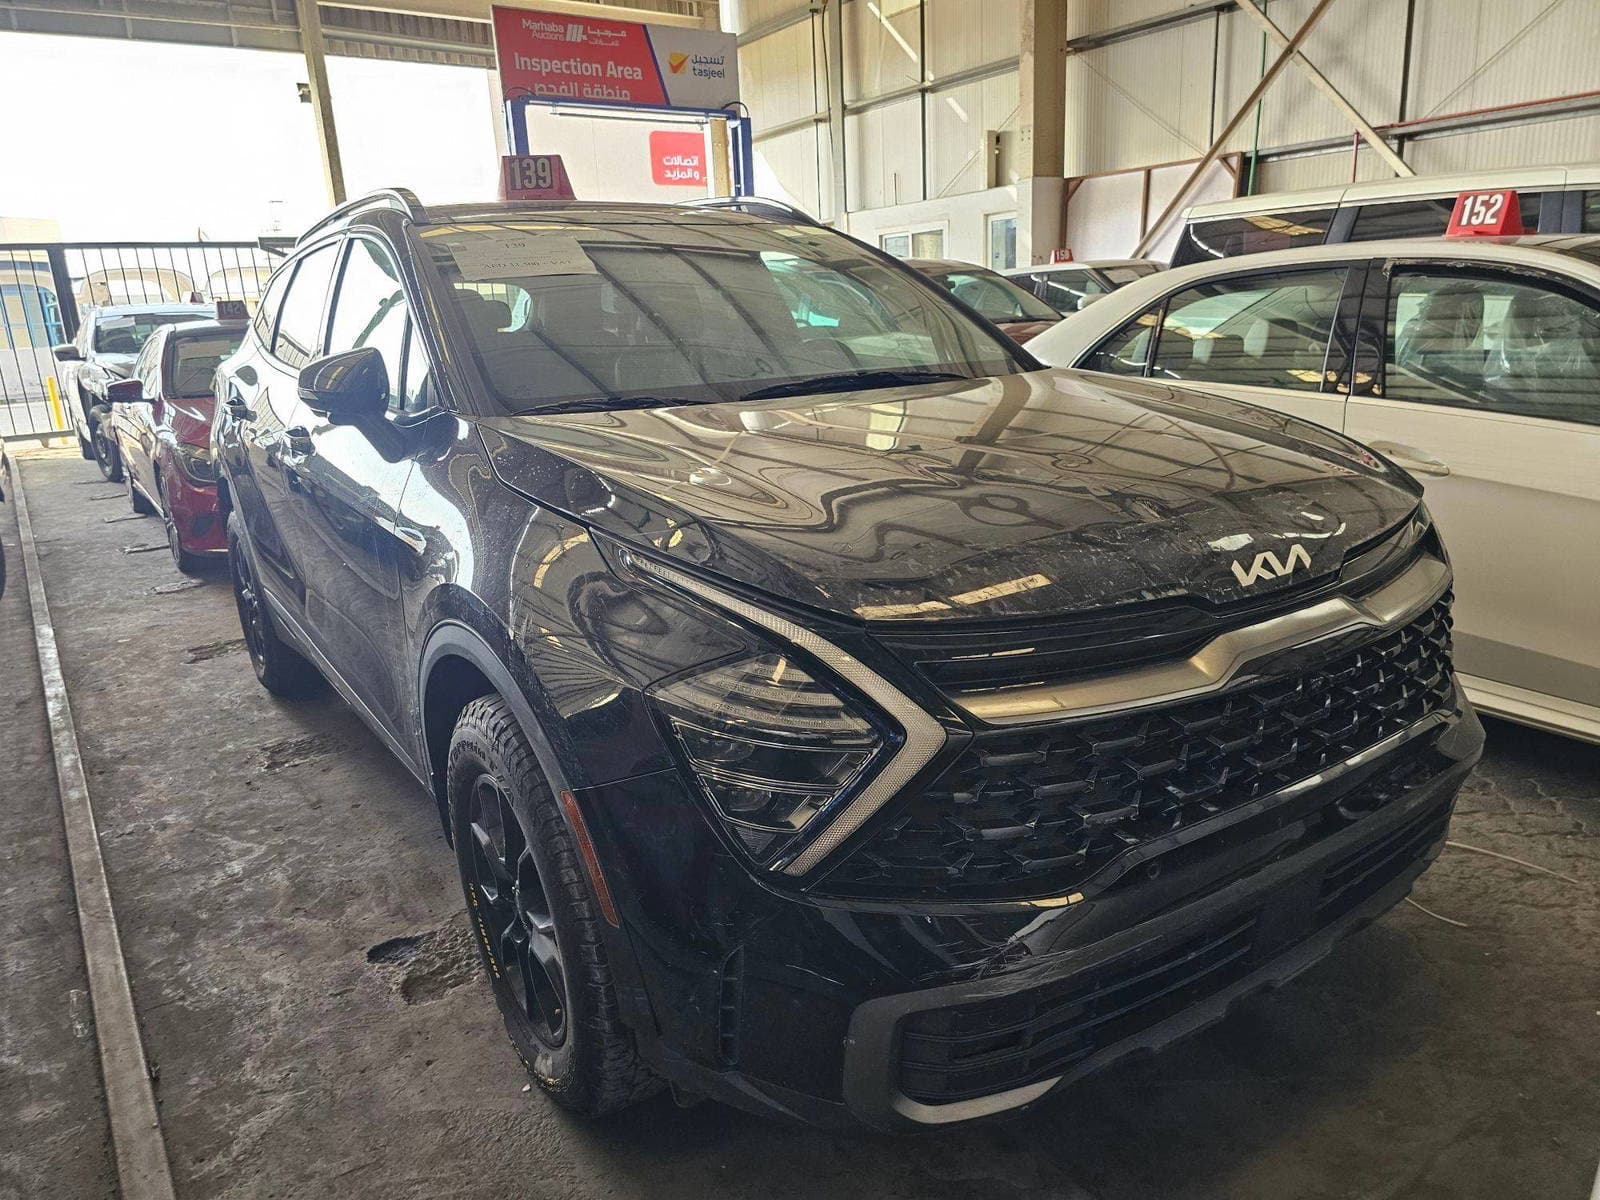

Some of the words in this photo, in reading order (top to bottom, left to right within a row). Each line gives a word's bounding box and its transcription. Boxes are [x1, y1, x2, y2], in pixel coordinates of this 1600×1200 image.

[521, 18, 564, 33] Marhaba
[514, 52, 602, 77] Inspection
[606, 61, 643, 80] Area
[692, 54, 725, 65] تسجيل
[693, 66, 725, 79] tasjeel
[582, 83, 631, 100] منطقة
[663, 155, 699, 166] اتصالات
[511, 158, 552, 189] 139
[1461, 193, 1504, 226] 152
[1231, 543, 1312, 587] KIA
